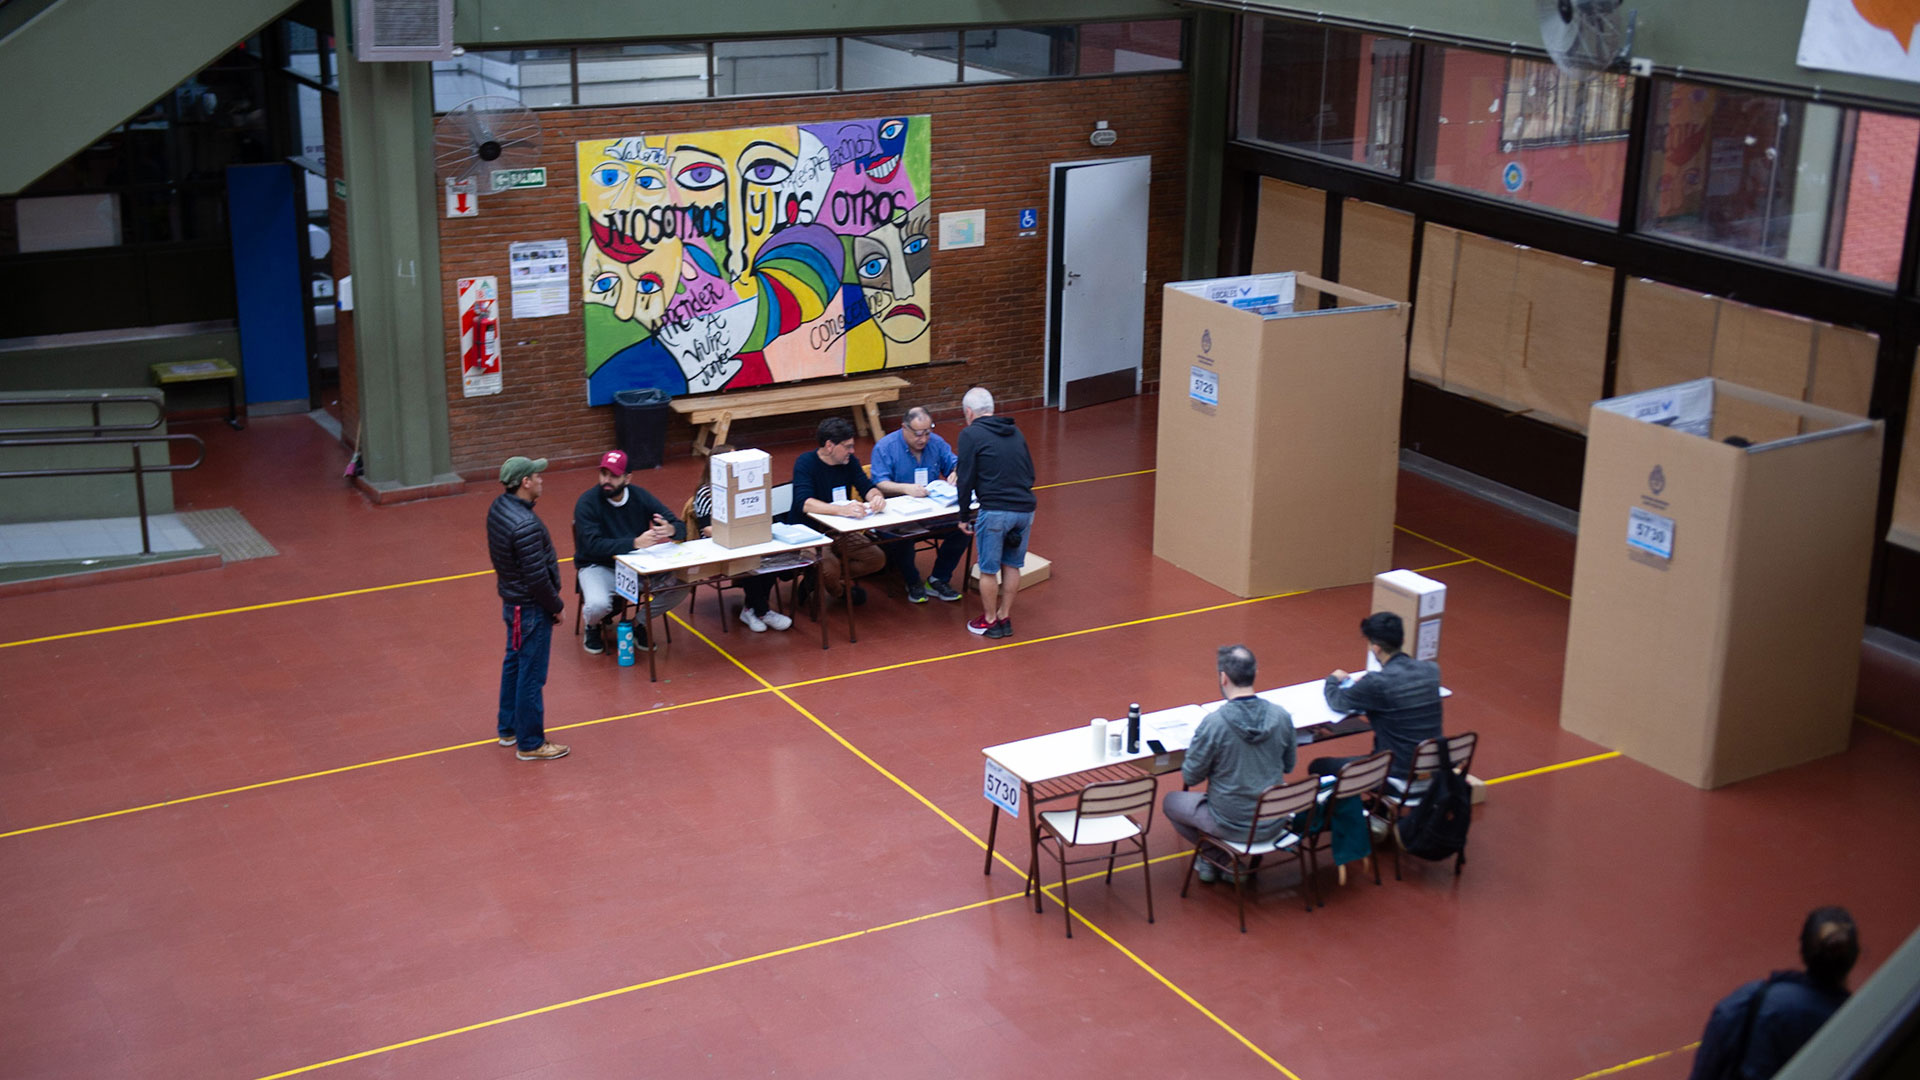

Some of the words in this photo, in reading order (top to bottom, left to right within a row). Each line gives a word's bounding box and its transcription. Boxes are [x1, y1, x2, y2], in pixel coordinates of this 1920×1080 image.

[511, 171, 543, 185] SALIDA
[604, 202, 730, 248] NOSOTROS
[832, 187, 909, 229] OTROS
[1211, 289, 1238, 300] LOCALES
[1194, 379, 1214, 395] 5729
[740, 495, 760, 506] 5729
[1636, 522, 1667, 544] 5730
[617, 571, 637, 595] 5729
[987, 773, 1017, 806] 5730
